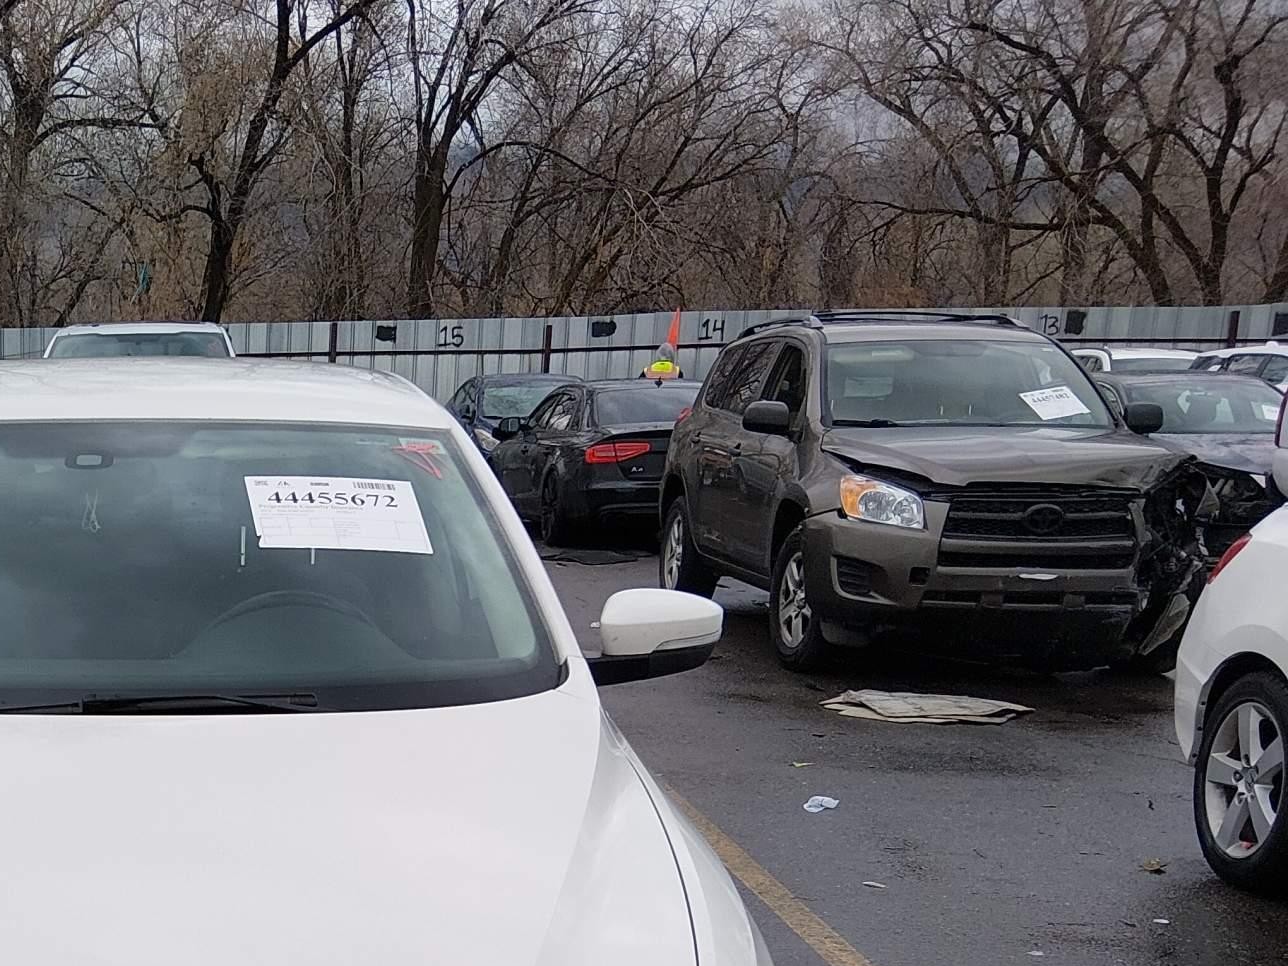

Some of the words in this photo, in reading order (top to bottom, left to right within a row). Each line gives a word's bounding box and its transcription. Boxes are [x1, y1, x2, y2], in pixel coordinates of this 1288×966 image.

[437, 325, 464, 347] 15
[698, 318, 725, 341] 14
[1040, 314, 1059, 336] 13
[267, 490, 399, 508] 44455672
